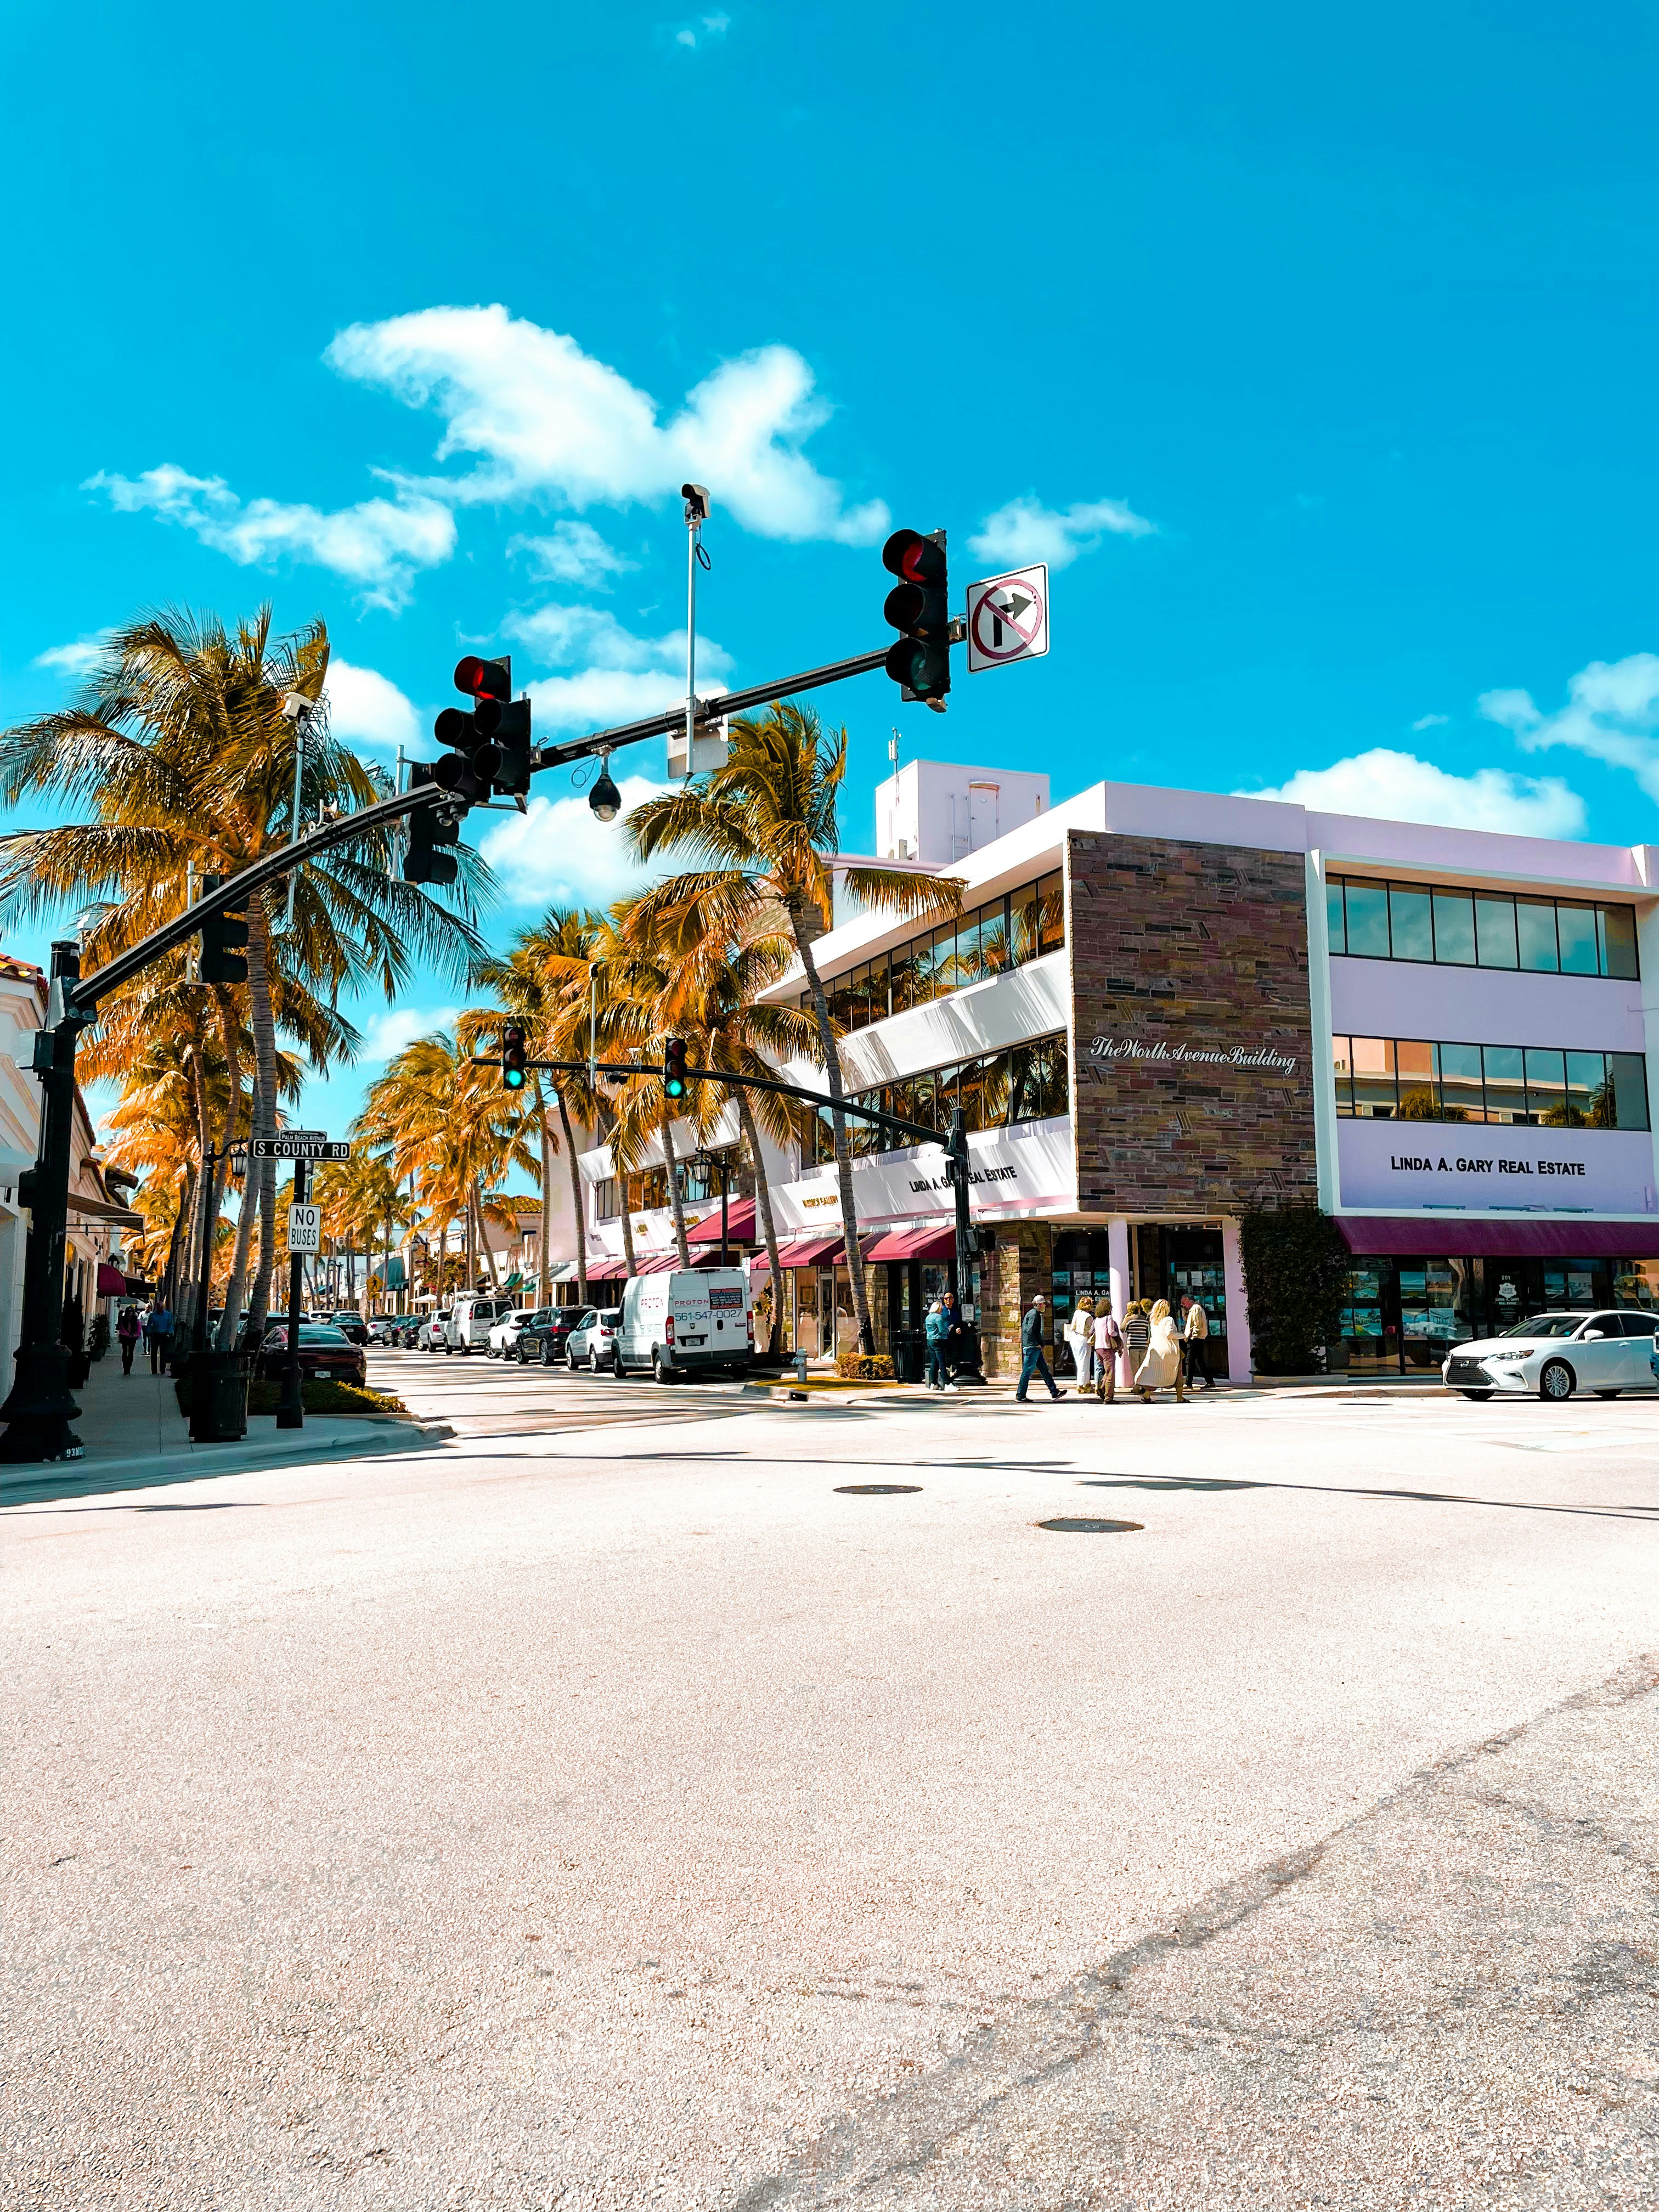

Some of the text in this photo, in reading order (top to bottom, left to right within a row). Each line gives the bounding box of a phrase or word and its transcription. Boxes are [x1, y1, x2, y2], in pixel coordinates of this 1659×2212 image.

[258, 1142, 348, 1157] S COUNTY RD
[1391, 1156, 1585, 1176] LINDA A. GARY REAL ESTATE
[909, 1178, 932, 1192] LINDA
[932, 1177, 943, 1190] A.
[984, 1166, 1018, 1182] ESTATE
[295, 1209, 315, 1226] NO
[291, 1228, 317, 1245] BUSES
[641, 1297, 664, 1309] PROTON
[675, 1309, 743, 1321] 561-547-0027
